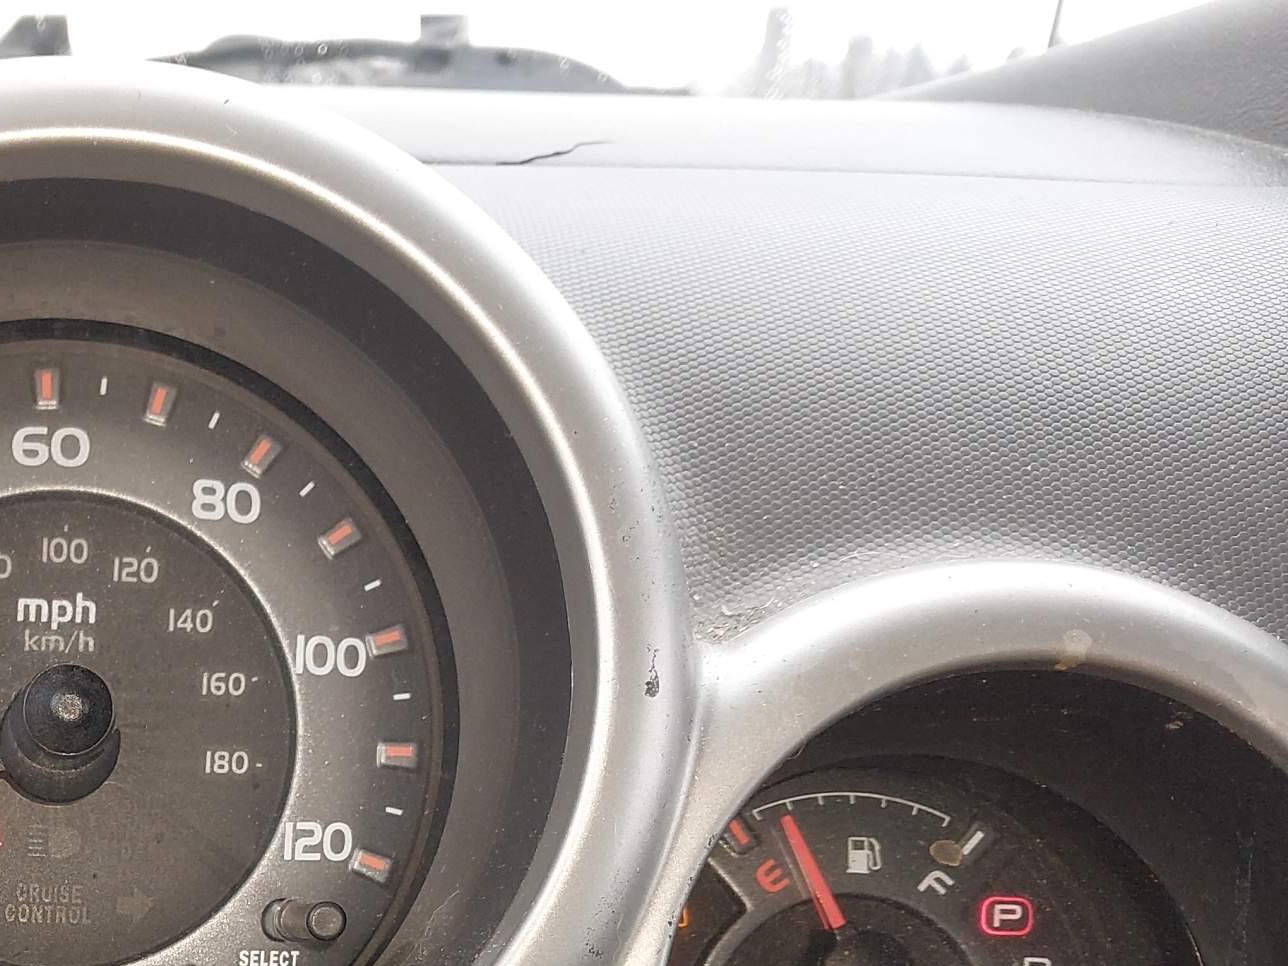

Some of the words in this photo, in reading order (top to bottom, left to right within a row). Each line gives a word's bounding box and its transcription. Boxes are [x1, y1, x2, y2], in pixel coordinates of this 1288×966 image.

[11, 426, 90, 468] 60
[191, 479, 261, 524] 80
[40, 536, 89, 564] 100
[112, 556, 159, 583] 120
[16, 592, 97, 630] mph
[168, 608, 213, 633] 140
[23, 629, 95, 654] km/h
[294, 634, 367, 678] 100
[201, 672, 246, 697] 160
[204, 751, 249, 775] 180
[283, 821, 353, 862] 120
[755, 859, 791, 893] E
[918, 869, 955, 895] F
[15, 882, 84, 903] CRUISE
[4, 903, 92, 925] CONTROL
[992, 904, 1023, 927] P
